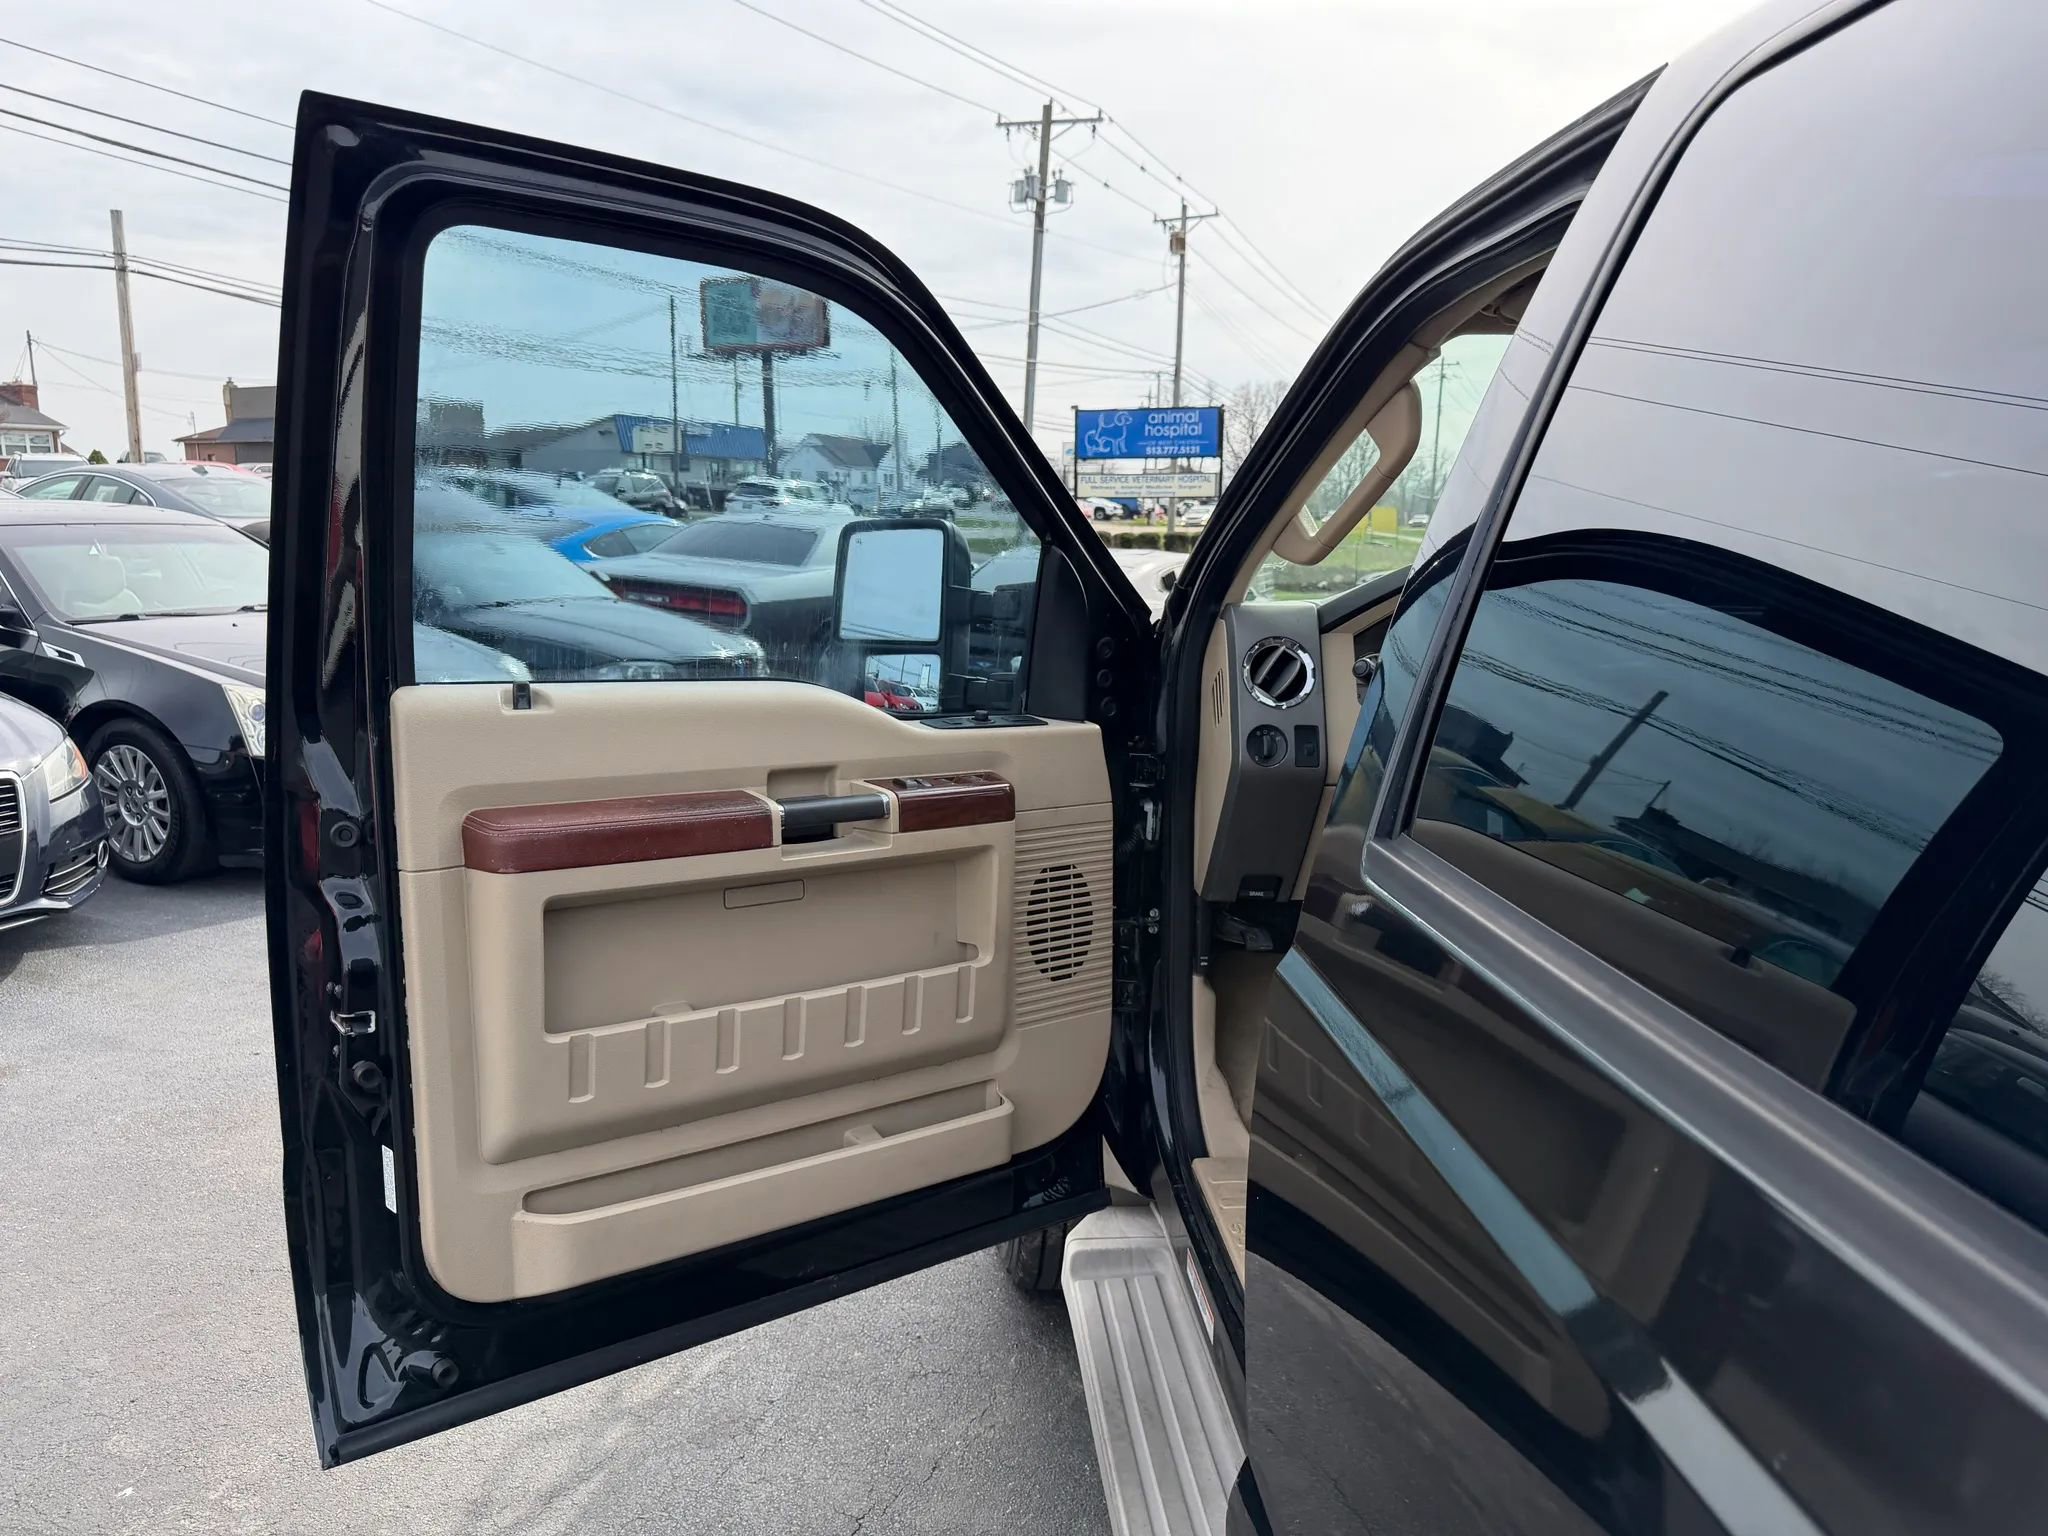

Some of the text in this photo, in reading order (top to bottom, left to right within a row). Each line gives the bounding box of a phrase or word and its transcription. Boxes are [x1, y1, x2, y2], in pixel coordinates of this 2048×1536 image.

[1148, 411, 1200, 424] animal
[1145, 423, 1202, 438] hospital
[1080, 476, 1098, 484] FULL
[1100, 476, 1129, 484] SERVICE
[1177, 475, 1212, 483] HOSPITAL
